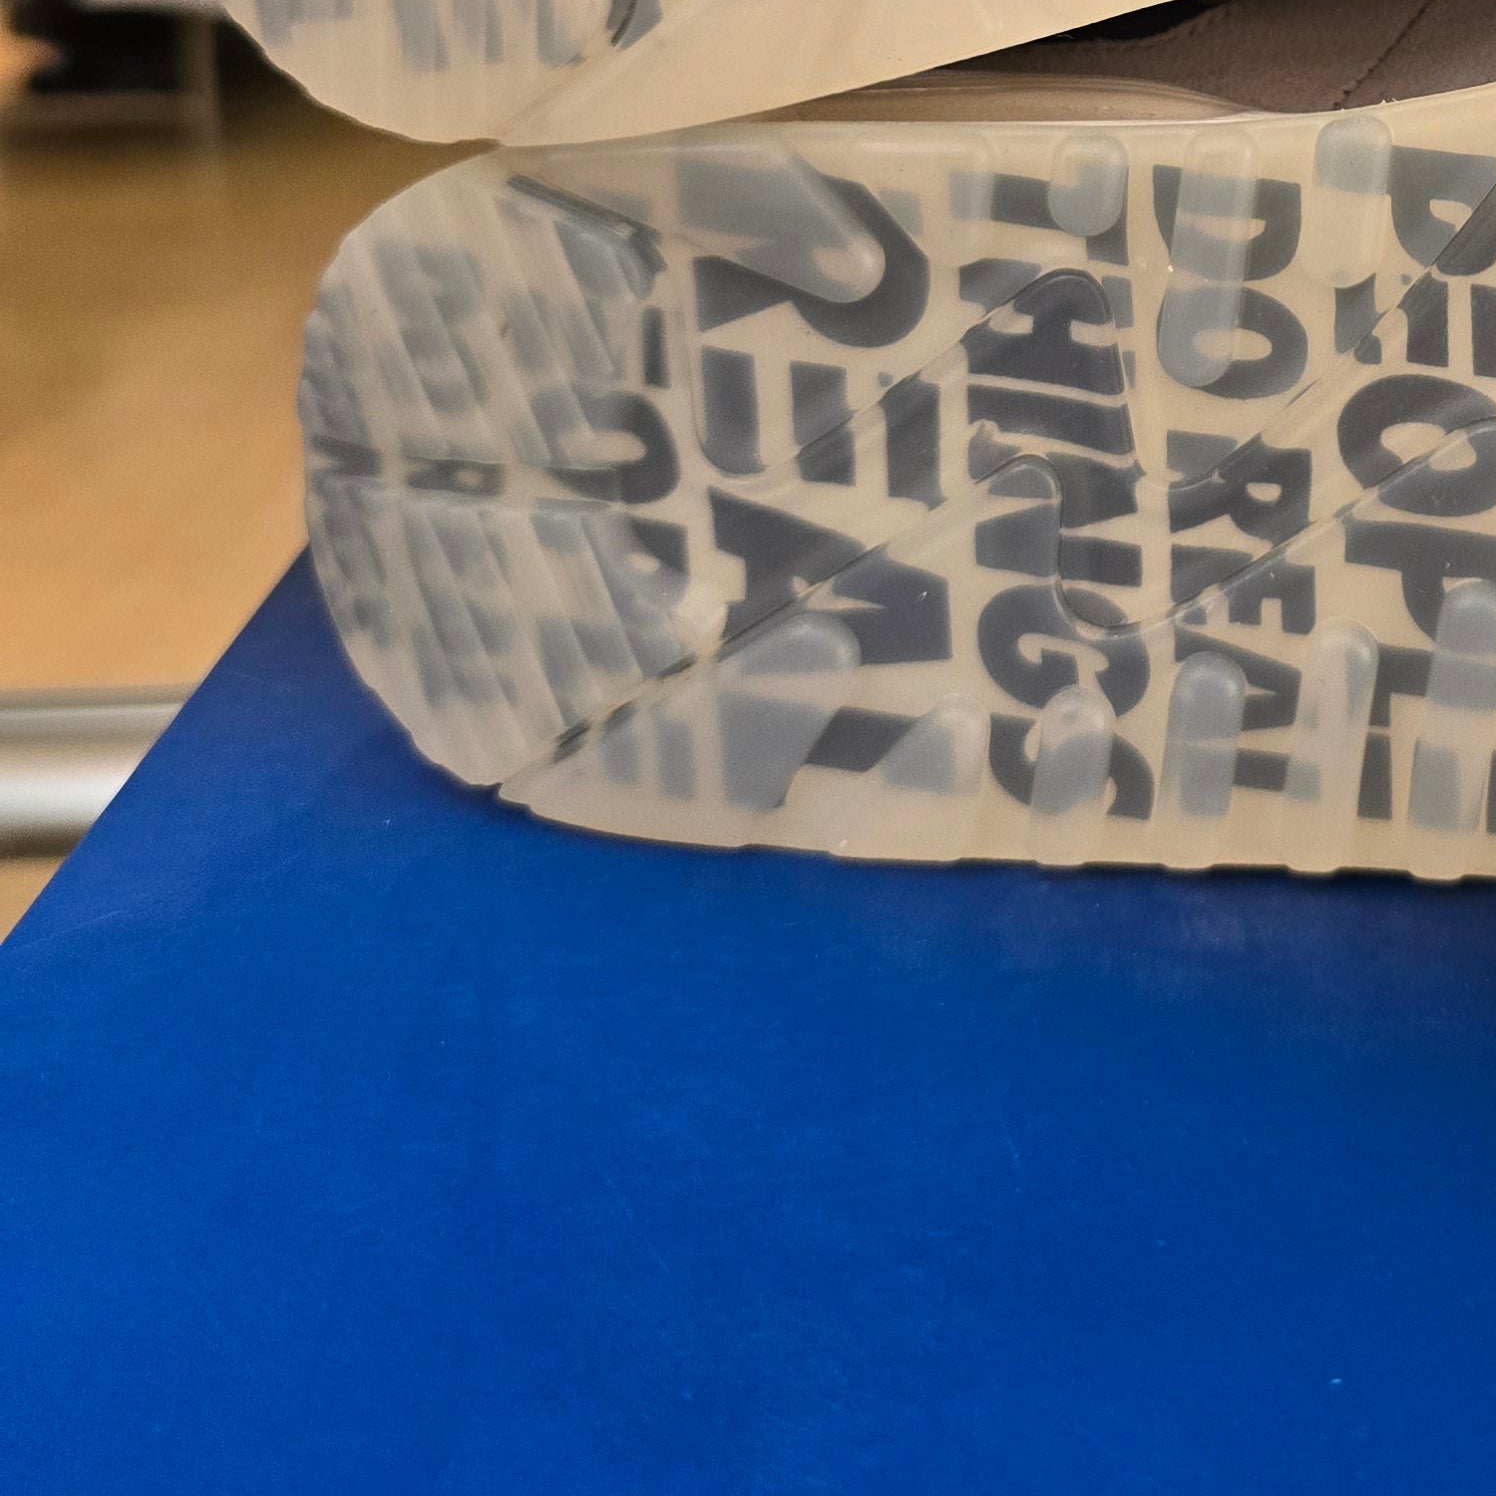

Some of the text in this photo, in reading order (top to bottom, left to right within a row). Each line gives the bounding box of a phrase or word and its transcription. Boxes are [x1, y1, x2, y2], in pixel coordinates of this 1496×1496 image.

[672, 156, 957, 811] REAL
[948, 164, 1155, 821] THINGS
[1153, 164, 1323, 818] DO REAL
